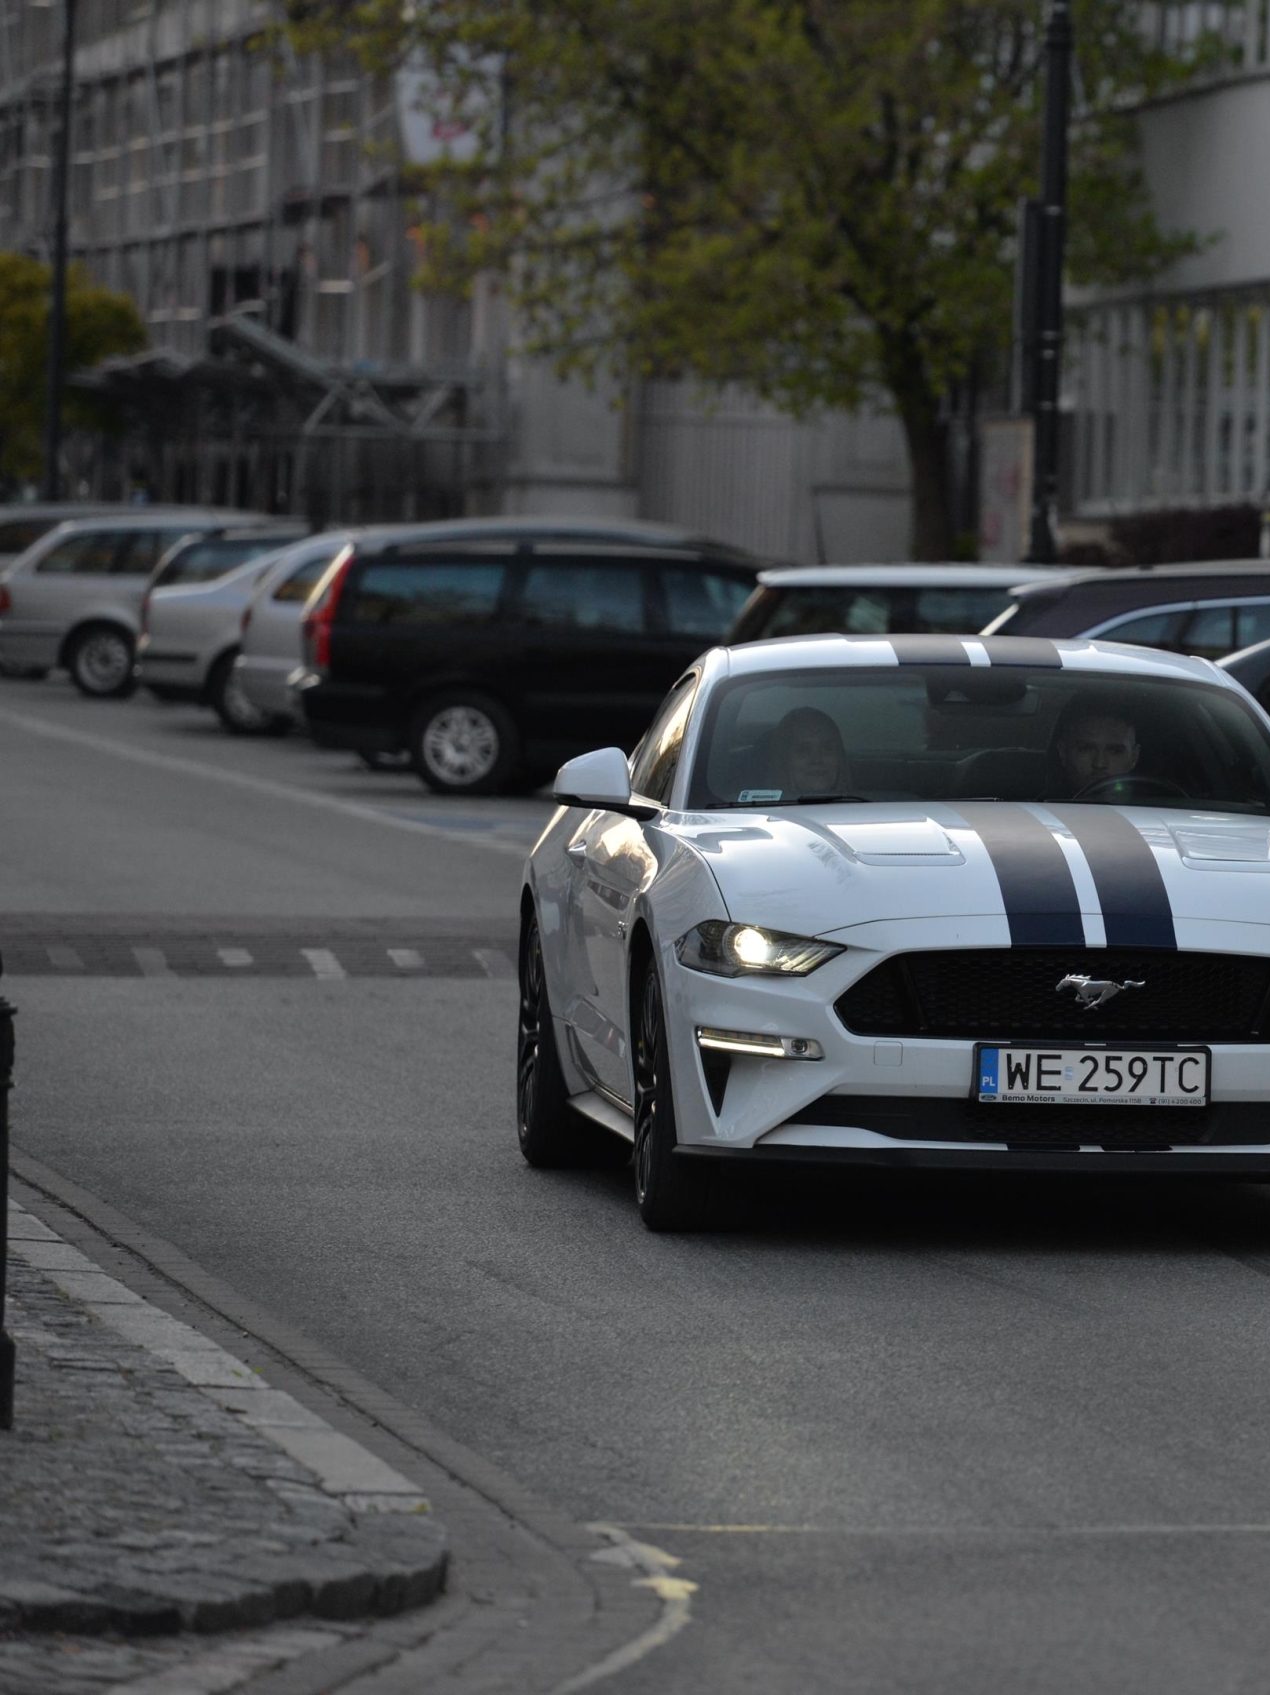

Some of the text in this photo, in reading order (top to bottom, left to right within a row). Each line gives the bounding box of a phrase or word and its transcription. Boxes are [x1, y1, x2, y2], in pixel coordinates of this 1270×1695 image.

[982, 1076, 995, 1087] PL
[1006, 1053, 1200, 1093] WE 259TC
